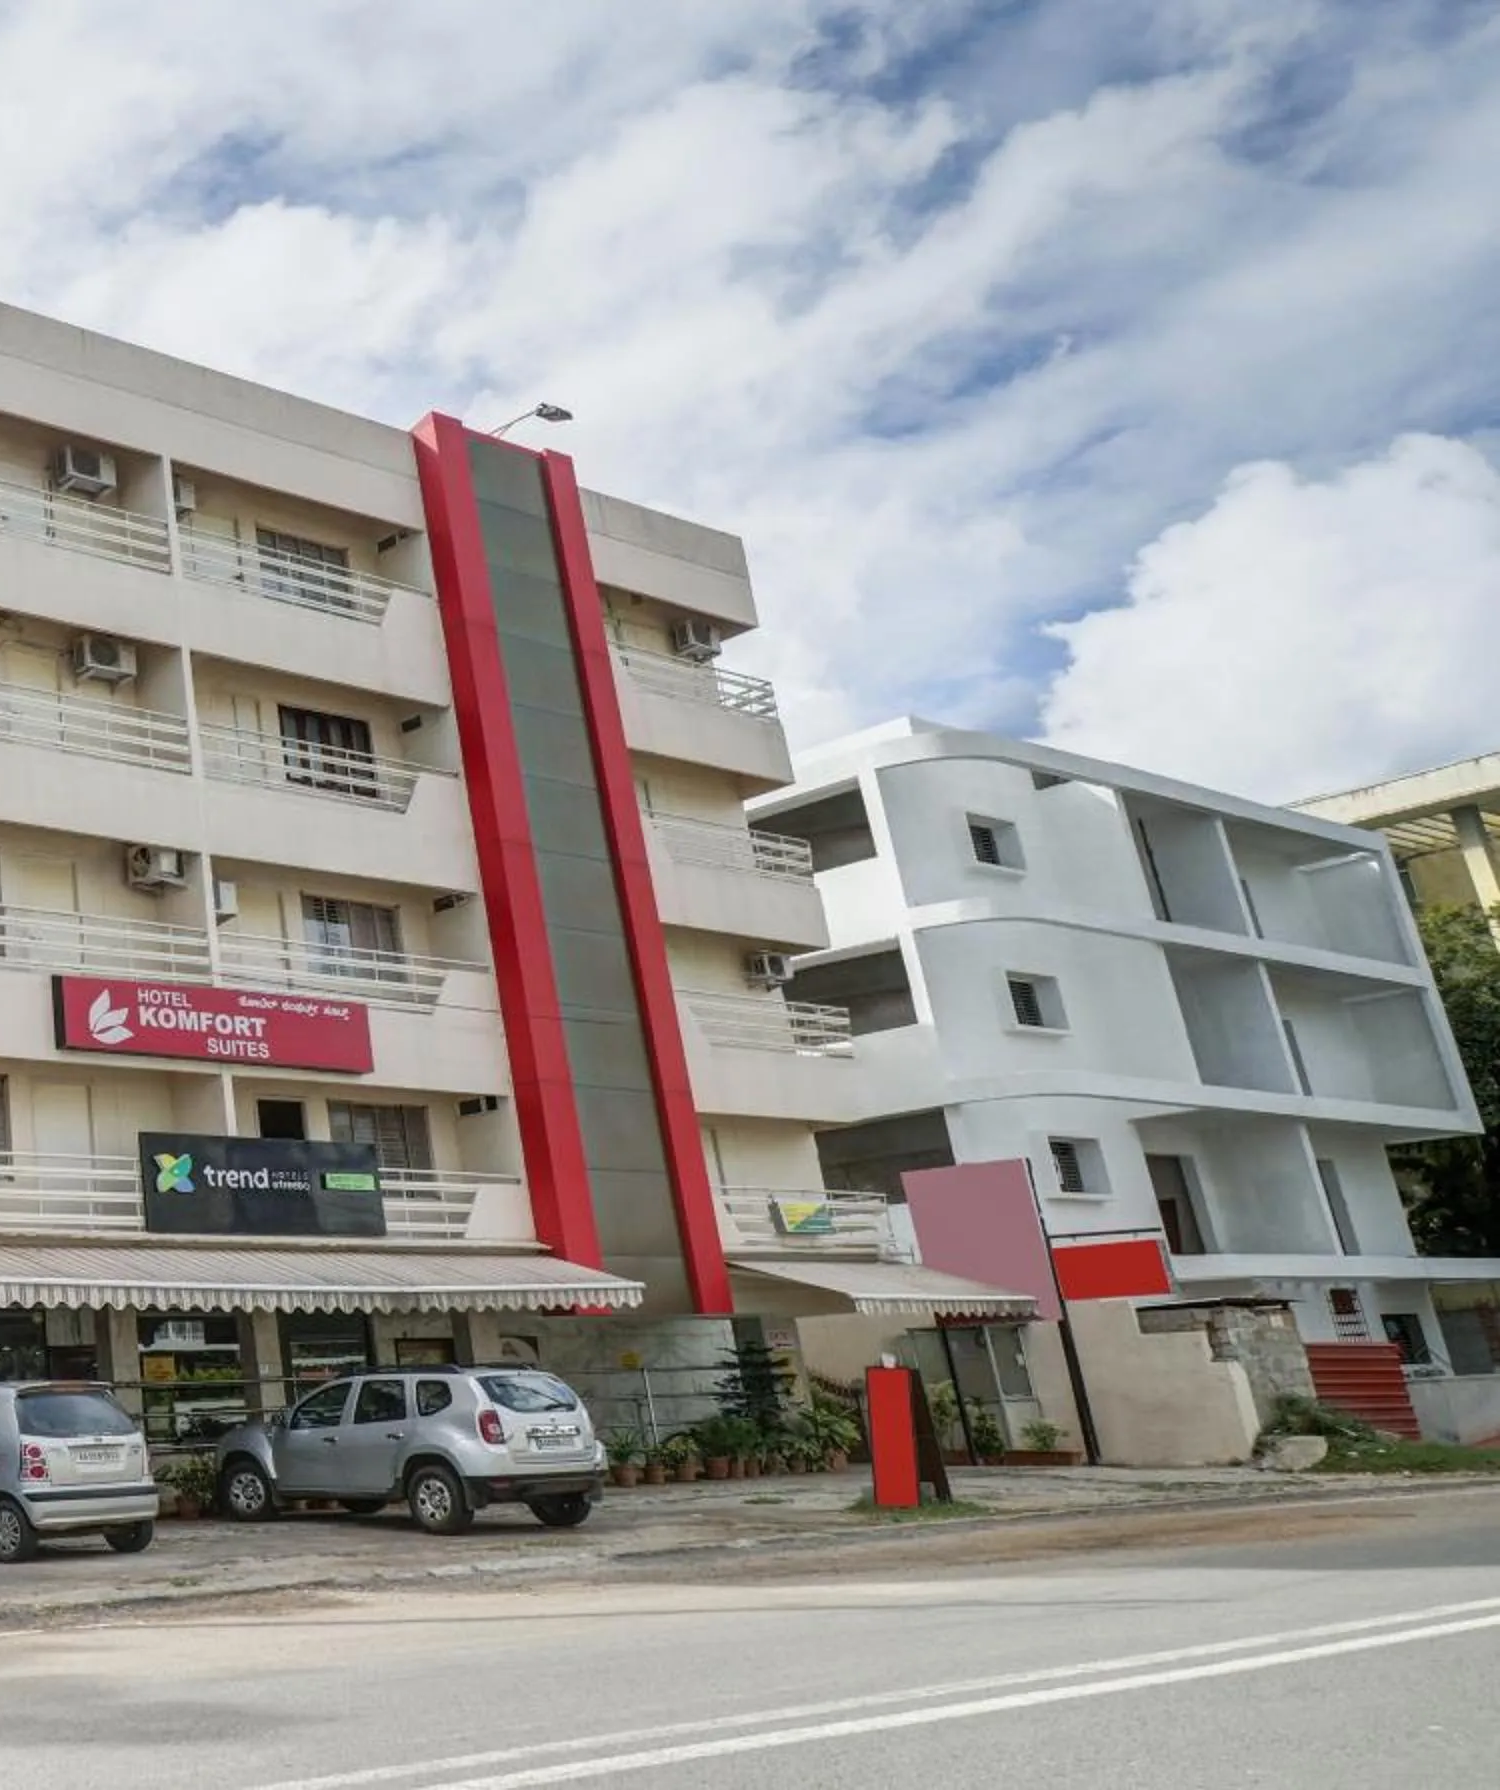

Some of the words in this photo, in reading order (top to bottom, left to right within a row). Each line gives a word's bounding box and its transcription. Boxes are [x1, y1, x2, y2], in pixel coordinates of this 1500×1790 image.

[137, 988, 192, 1008] HOTEL
[138, 1006, 267, 1037] KOMFORT
[207, 1037, 271, 1059] SUITES
[203, 1164, 269, 1189] trend
[271, 1170, 309, 1181] HOTELS
